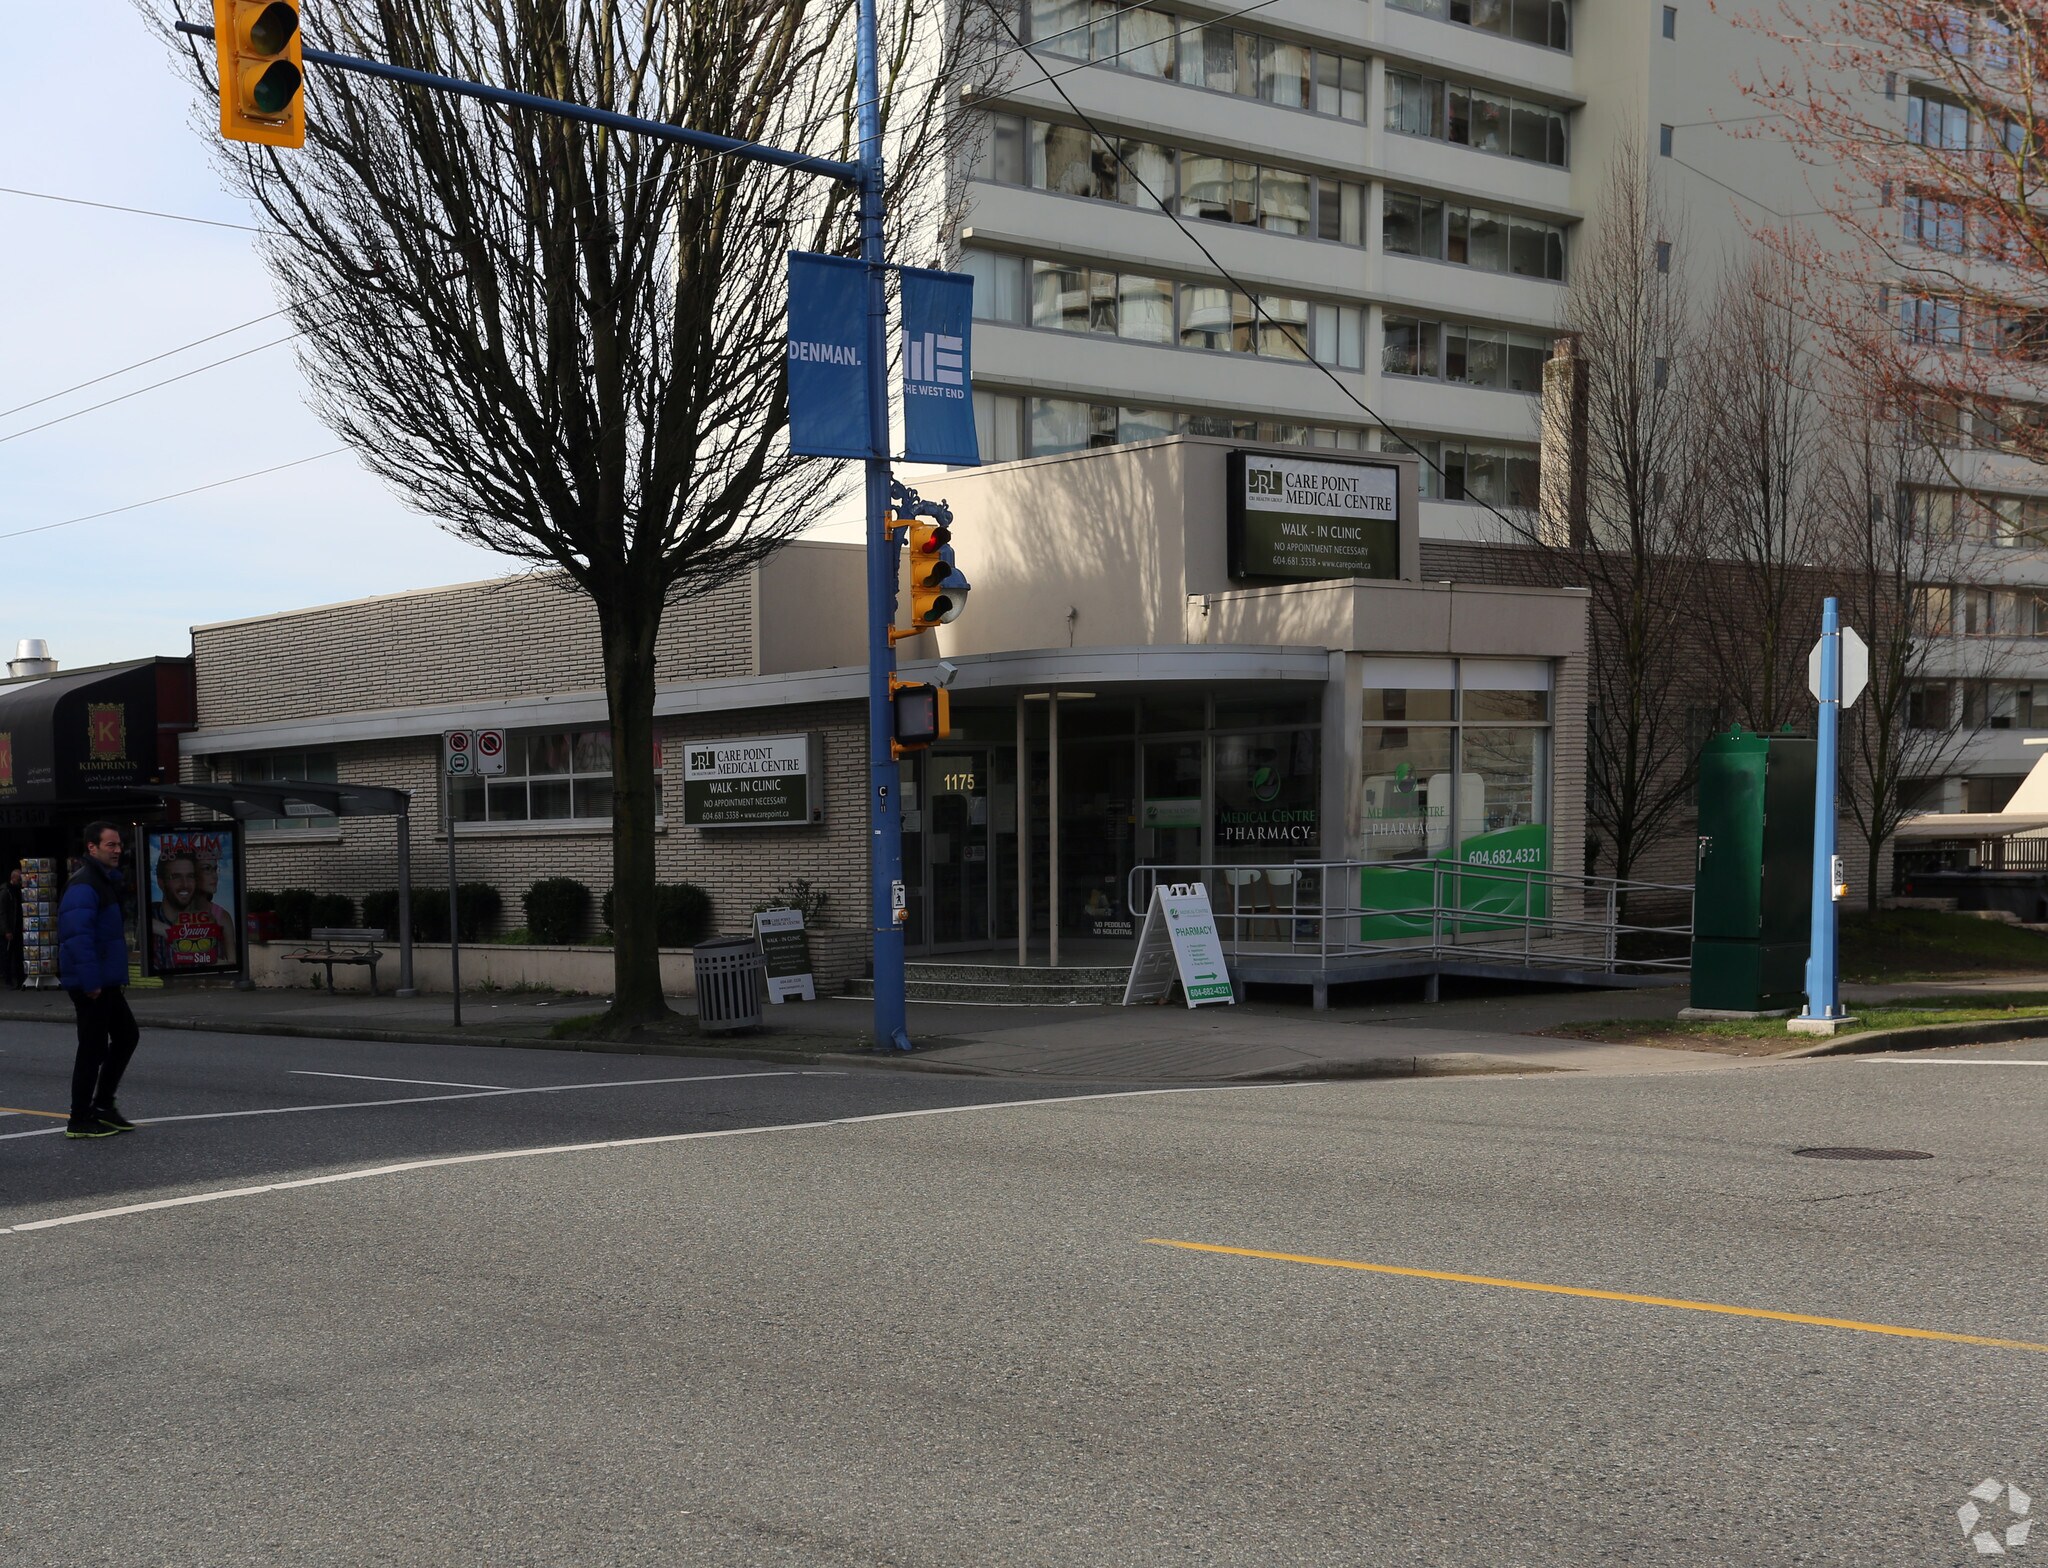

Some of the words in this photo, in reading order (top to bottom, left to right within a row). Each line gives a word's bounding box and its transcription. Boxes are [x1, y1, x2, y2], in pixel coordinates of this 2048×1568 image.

[789, 340, 862, 366] DENMAN.
[918, 385, 943, 397] WEST
[945, 388, 965, 400] END
[1285, 472, 1318, 490] CARE
[1321, 475, 1360, 493] POINT
[1285, 490, 1342, 508] MEDICAL
[1344, 494, 1392, 512] CENTRE
[1281, 522, 1308, 537] WALK
[1317, 525, 1328, 538] IN
[1330, 526, 1362, 540] CLINIC
[1274, 542, 1285, 551] NO
[1286, 542, 1333, 554] APPOINTMENT
[1333, 545, 1369, 556] NECESSARY
[1272, 556, 1317, 567] 604.681.5338
[1321, 559, 1371, 571] www.carepoint.ca
[99, 721, 115, 742] K
[717, 749, 742, 762] CARE
[743, 747, 773, 761] POINT
[79, 761, 138, 770] KIMPRINTS
[717, 761, 760, 775] MEDICAL
[761, 758, 800, 773] CENTRE
[709, 782, 733, 794] WALK
[740, 780, 750, 793] IN
[751, 779, 782, 792] CLINIC
[944, 773, 975, 791] 1175
[703, 799, 714, 808] NO
[714, 798, 755, 807] APPOINTMENT
[755, 796, 788, 806] NECESSARY
[702, 811, 740, 821] 604.681.5338
[743, 810, 790, 819] www.carepoint.ca
[1219, 810, 1270, 824] MEDICAL
[1271, 808, 1316, 823] CENTRE
[159, 832, 222, 854] HAKIM
[1468, 847, 1541, 865] 604.682.4321
[178, 911, 210, 922] BIG
[178, 922, 211, 940] Spring
[1102, 928, 1133, 936] SOLICITING
[1103, 921, 1131, 929] PEDDLING
[1175, 924, 1213, 937] PHARMACY
[194, 952, 211, 963] Sale
[1190, 985, 1230, 998] 604-682-4321
